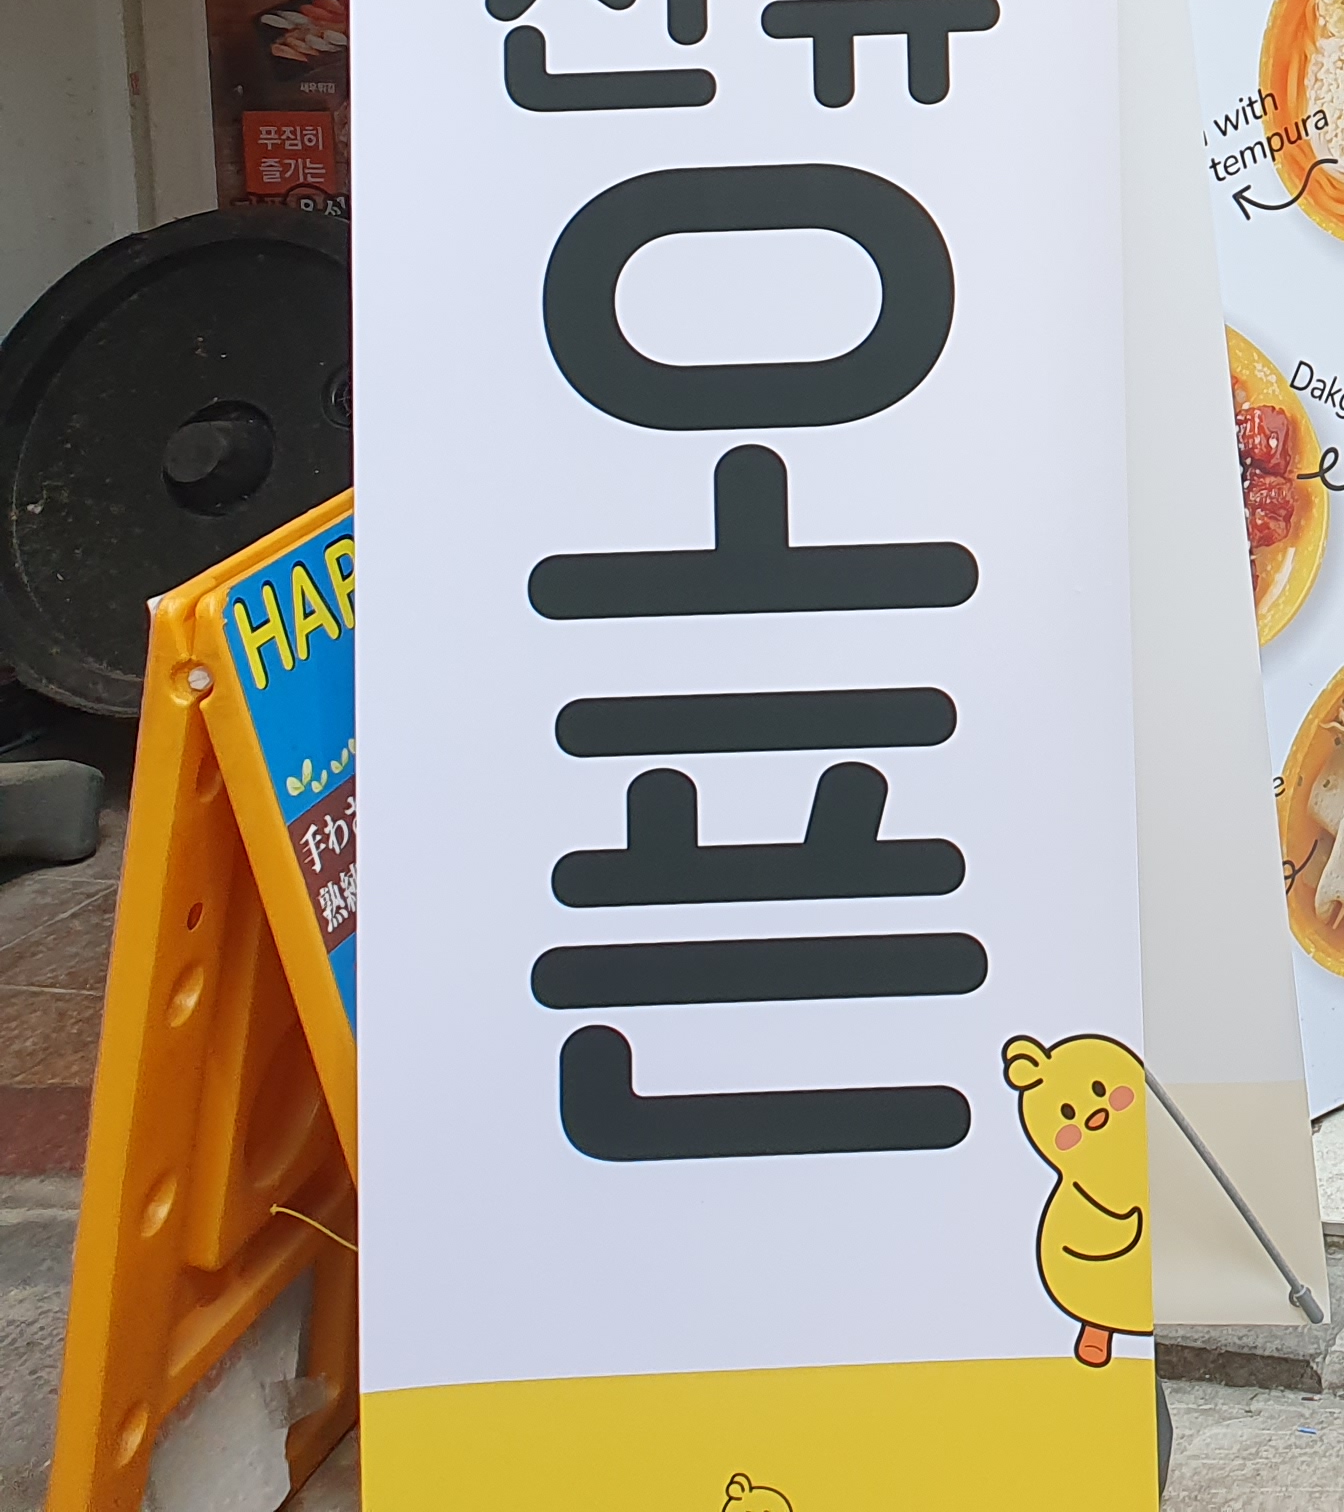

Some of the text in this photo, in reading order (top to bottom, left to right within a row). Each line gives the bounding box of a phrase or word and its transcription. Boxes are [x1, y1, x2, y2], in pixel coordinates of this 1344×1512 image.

[1213, 88, 1279, 137] with
[257, 126, 323, 151] 푸짐히
[1208, 109, 1329, 182] tempura
[258, 157, 327, 184] 즐기는
[527, 162, 988, 1161] 오픈
